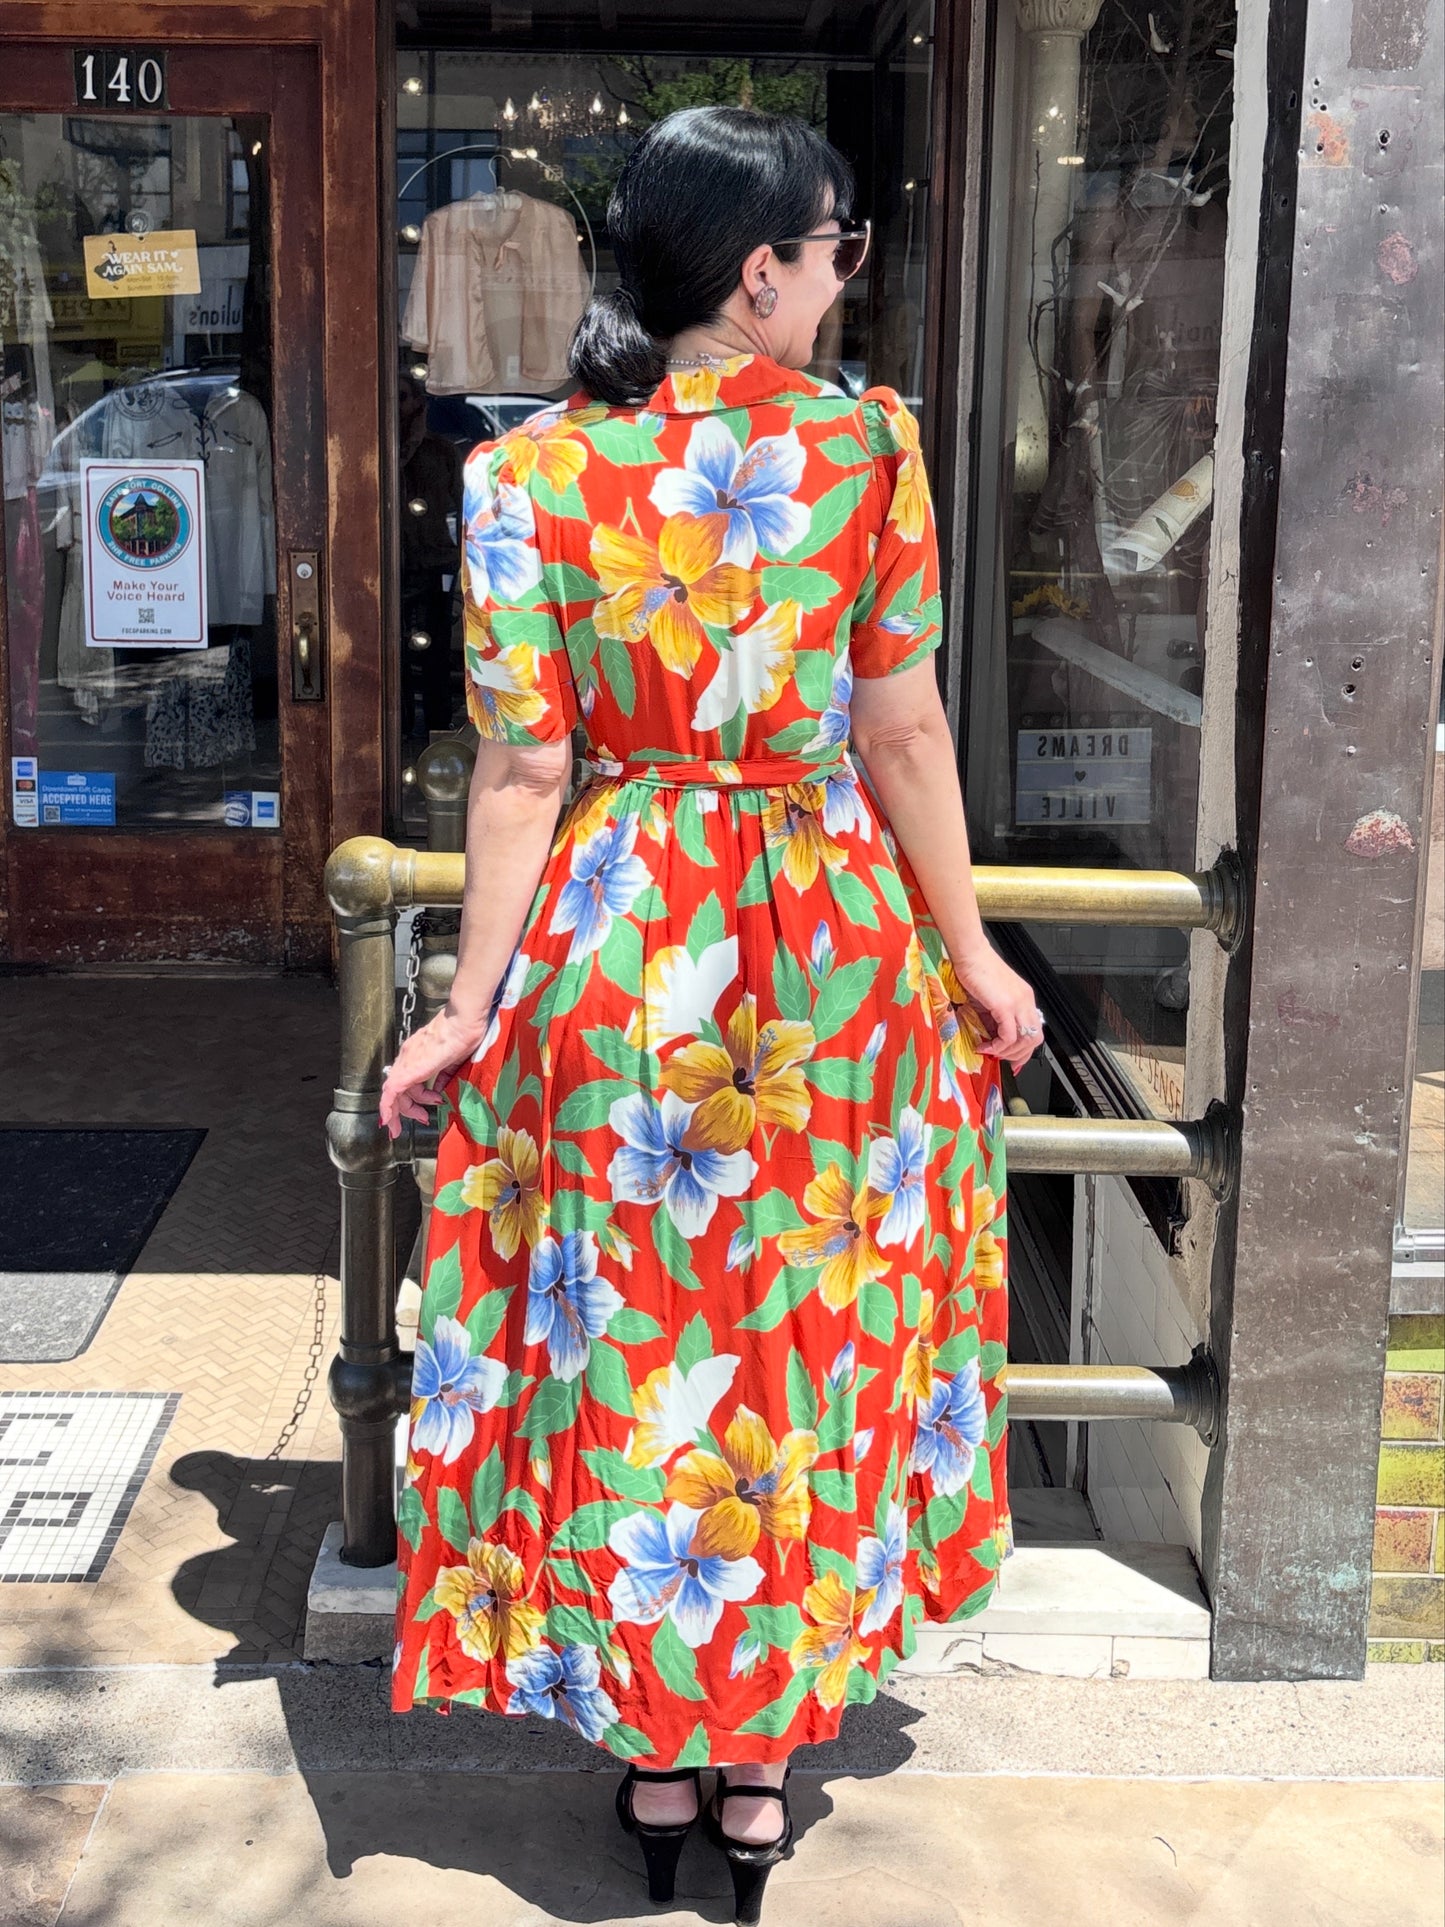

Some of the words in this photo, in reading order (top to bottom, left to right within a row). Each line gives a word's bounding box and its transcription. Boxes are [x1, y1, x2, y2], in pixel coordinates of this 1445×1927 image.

[82, 55, 163, 103] 140
[102, 250, 152, 265] WEAR
[153, 250, 168, 262] IT
[102, 263, 144, 277] AGAIN
[147, 262, 184, 274] SAM
[126, 480, 147, 490] FORT
[151, 482, 182, 509] COLLINS
[123, 553, 146, 566] FREE
[150, 543, 182, 566] PARKING
[113, 580, 146, 590] Make
[150, 580, 179, 591] Your
[107, 591, 142, 601] Voice
[147, 591, 185, 602] Heard
[42, 793, 87, 805] ACCEPTED
[89, 794, 112, 806] HERE
